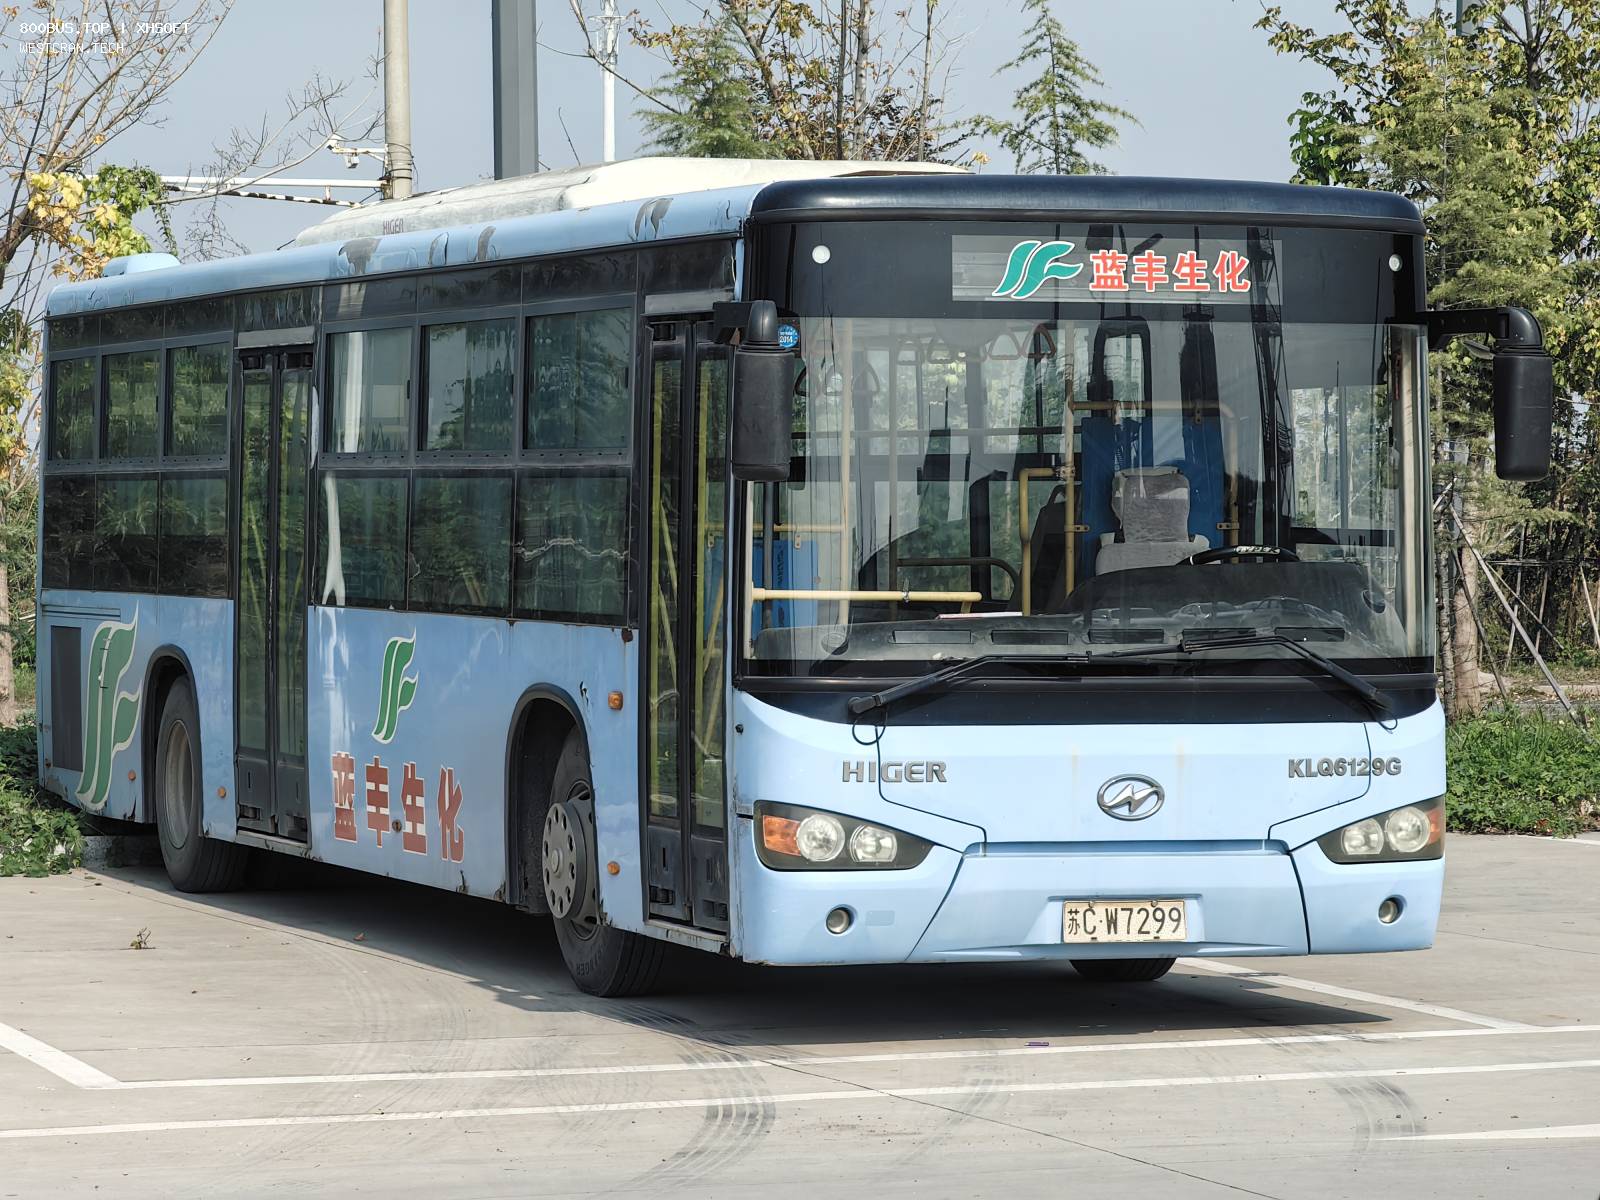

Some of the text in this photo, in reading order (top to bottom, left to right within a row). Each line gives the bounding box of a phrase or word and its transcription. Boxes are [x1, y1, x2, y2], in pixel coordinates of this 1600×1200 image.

[383, 218, 404, 235] HIGER
[1089, 249, 1252, 292] 蓝丰生化
[842, 760, 947, 783] HIGER
[1288, 757, 1402, 778] KLQ6129G
[331, 751, 465, 863] 蓝丰生化
